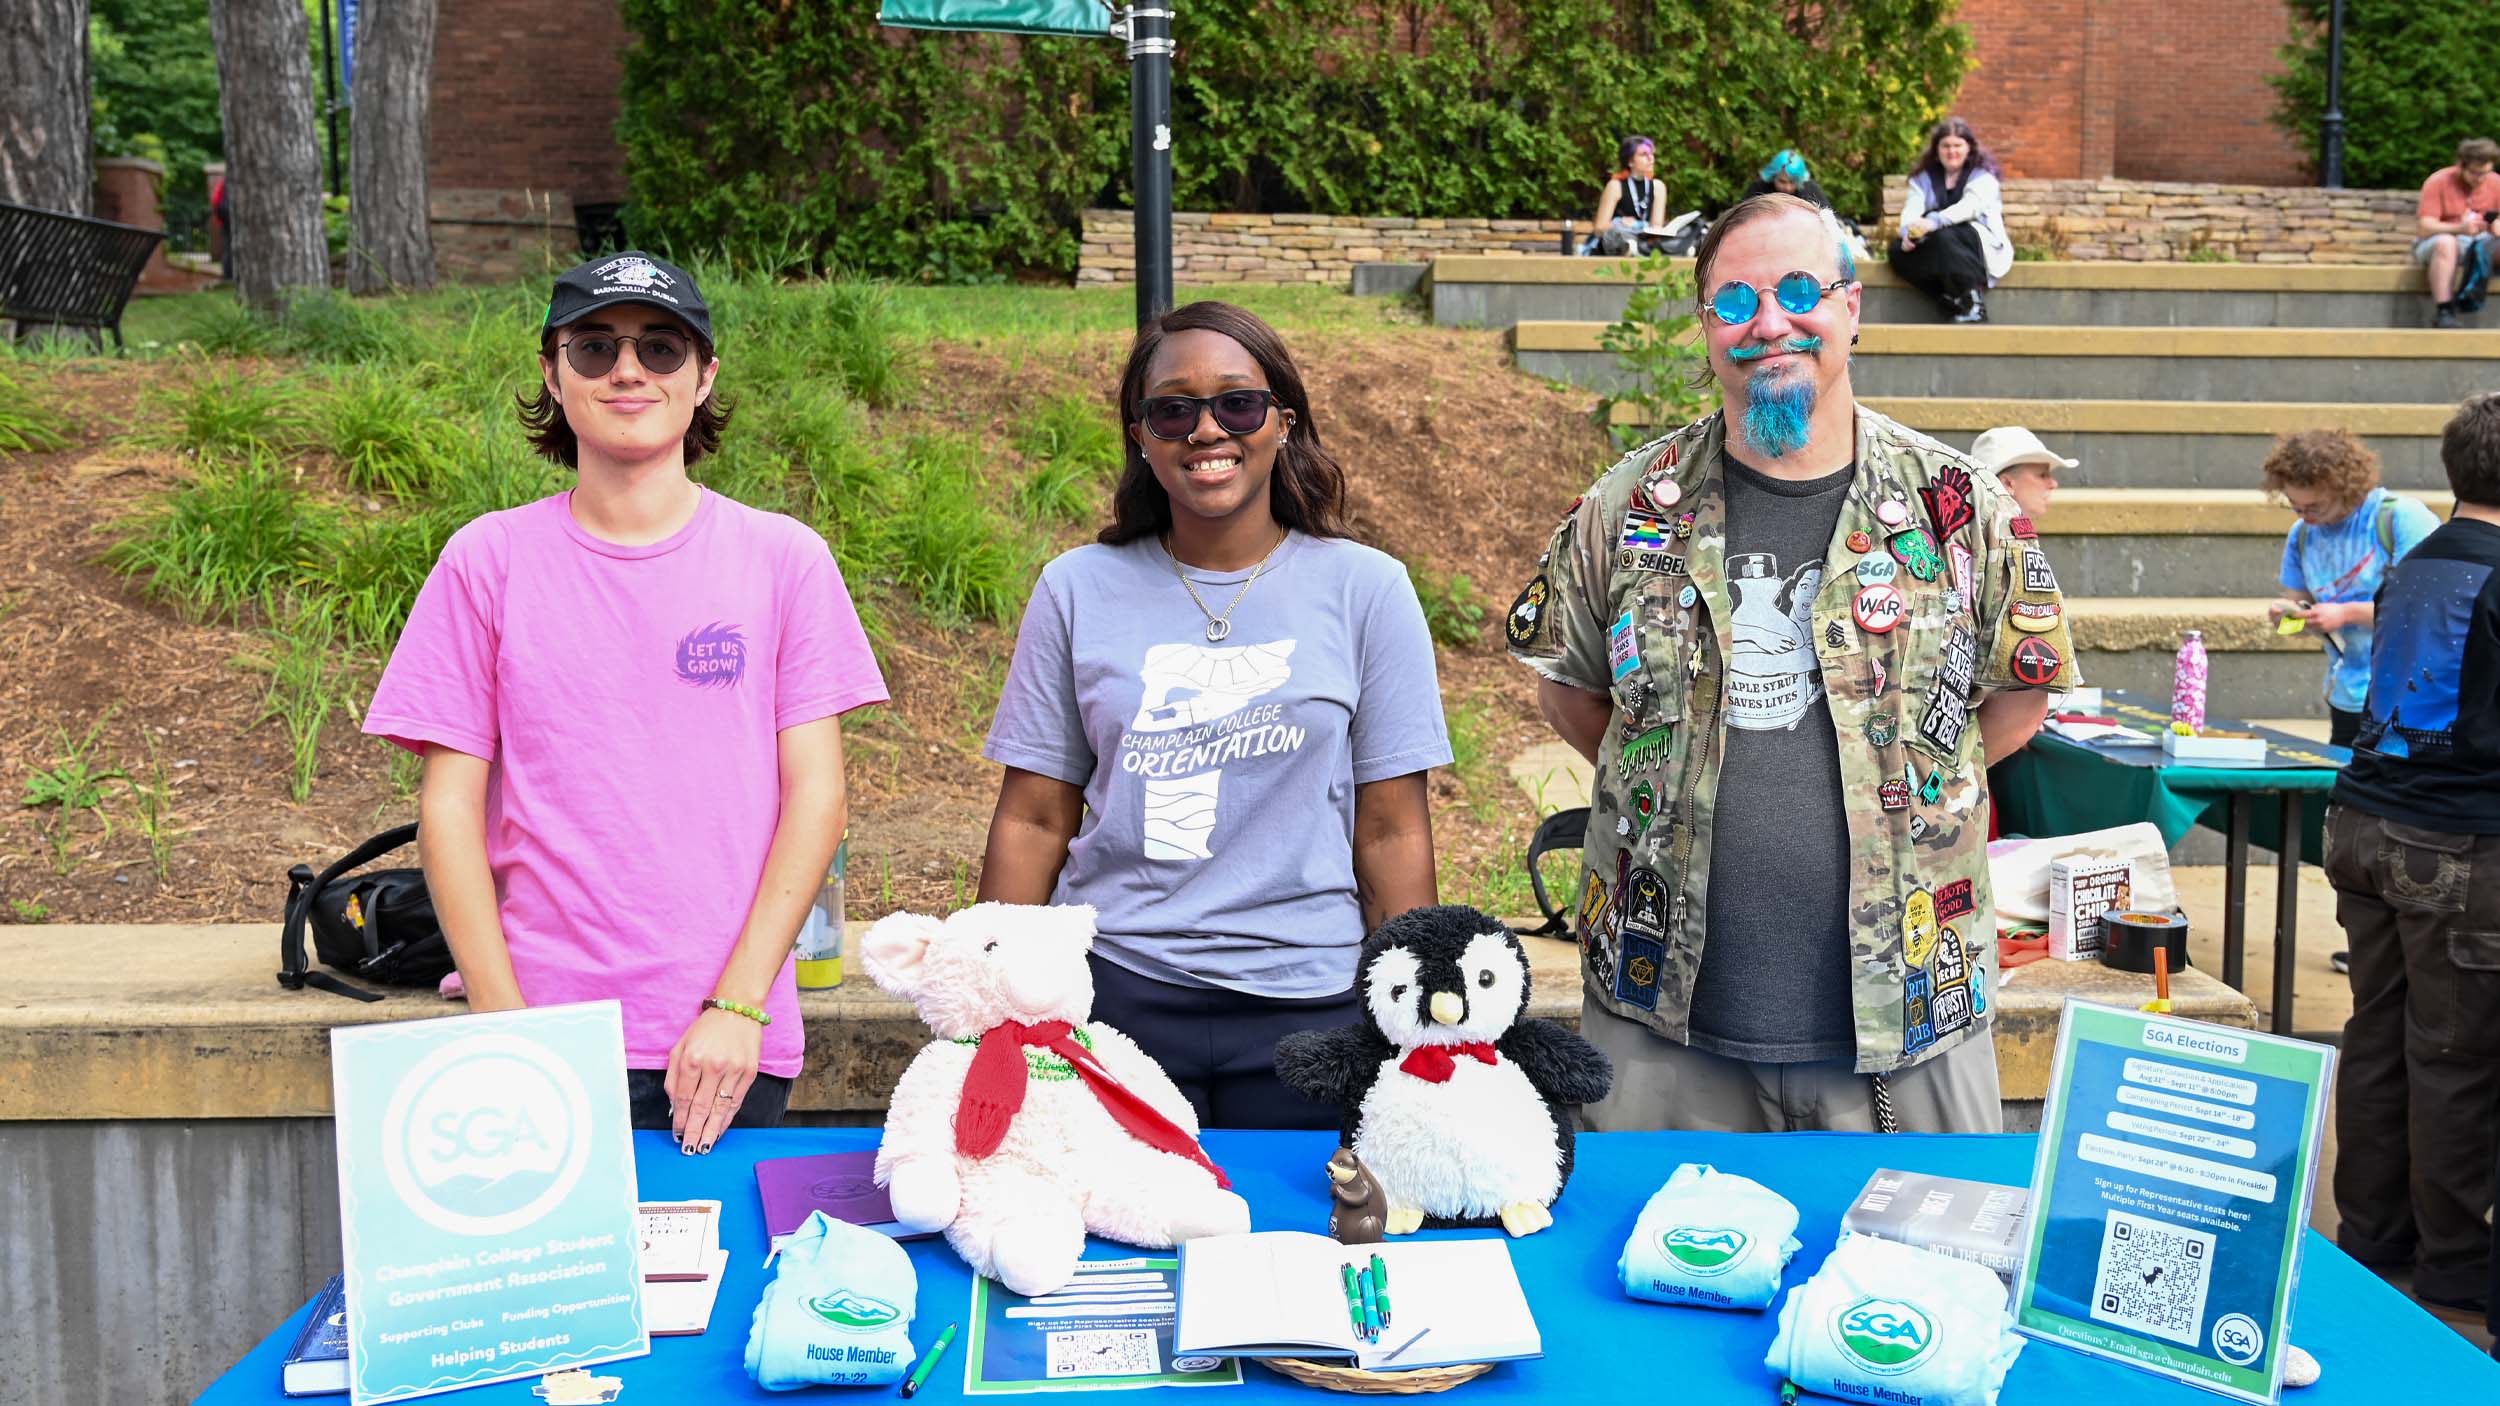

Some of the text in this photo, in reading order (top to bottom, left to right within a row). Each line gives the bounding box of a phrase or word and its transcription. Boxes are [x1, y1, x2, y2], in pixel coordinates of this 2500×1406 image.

[1638, 553, 1686, 575] SEIBEL
[1857, 561, 1894, 577] SGA
[1860, 597, 1900, 616] WAR
[2015, 604, 2036, 616] FROST
[688, 641, 739, 657] LET US
[1952, 628, 1976, 657] BLAC
[687, 658, 738, 674] GROW!
[2022, 655, 2058, 667] TRMP
[1729, 673, 1799, 694] APLE SYRUP
[1728, 691, 1798, 709] SAVES LIVES
[1935, 684, 1967, 727] SCIENC
[1122, 703, 1282, 751] CHAMPLAIN COLLEGE
[1924, 707, 1942, 734] IS
[1122, 725, 1305, 778] ORIENTATION
[2089, 871, 2125, 886] ORGANIC
[2074, 884, 2116, 906] CHOCOLATE
[1939, 898, 1963, 917] GOOD
[2075, 901, 2110, 920] CHIP
[1935, 989, 1966, 1021] FROST
[2146, 1029, 2240, 1057] SGA Elections
[2210, 1087, 2239, 1100] 5:00pm
[2195, 1106, 2213, 1117] Sept
[431, 1103, 551, 1163] SGA
[2179, 1131, 2197, 1142] Sept
[2236, 1177, 2269, 1191] Fireside!
[2095, 1177, 2251, 1222] Sign up for Representative seats here!
[2101, 1191, 2242, 1232] Multiple First Year seats available.
[1670, 1231, 1736, 1249] SGA
[377, 1233, 615, 1283] Champlain College Student
[1959, 1248, 1980, 1264] THE
[1982, 1252, 2016, 1270] GREAT
[389, 1260, 607, 1308] Government Association
[1653, 1280, 1734, 1304] House Member
[502, 1293, 632, 1323] Funding Opportunities
[379, 1316, 485, 1345] Supporting Clubs
[1845, 1311, 1922, 1345] SGA
[431, 1332, 571, 1369] Helping Students
[2058, 1324, 2109, 1349] Questions?
[2109, 1338, 2138, 1357] Email
[2222, 1329, 2252, 1350] SGA
[807, 1344, 897, 1365] House Member
[1182, 1358, 1210, 1369] SGA
[831, 1372, 868, 1384] '21-'22
[1833, 1378, 1923, 1406] House Member
